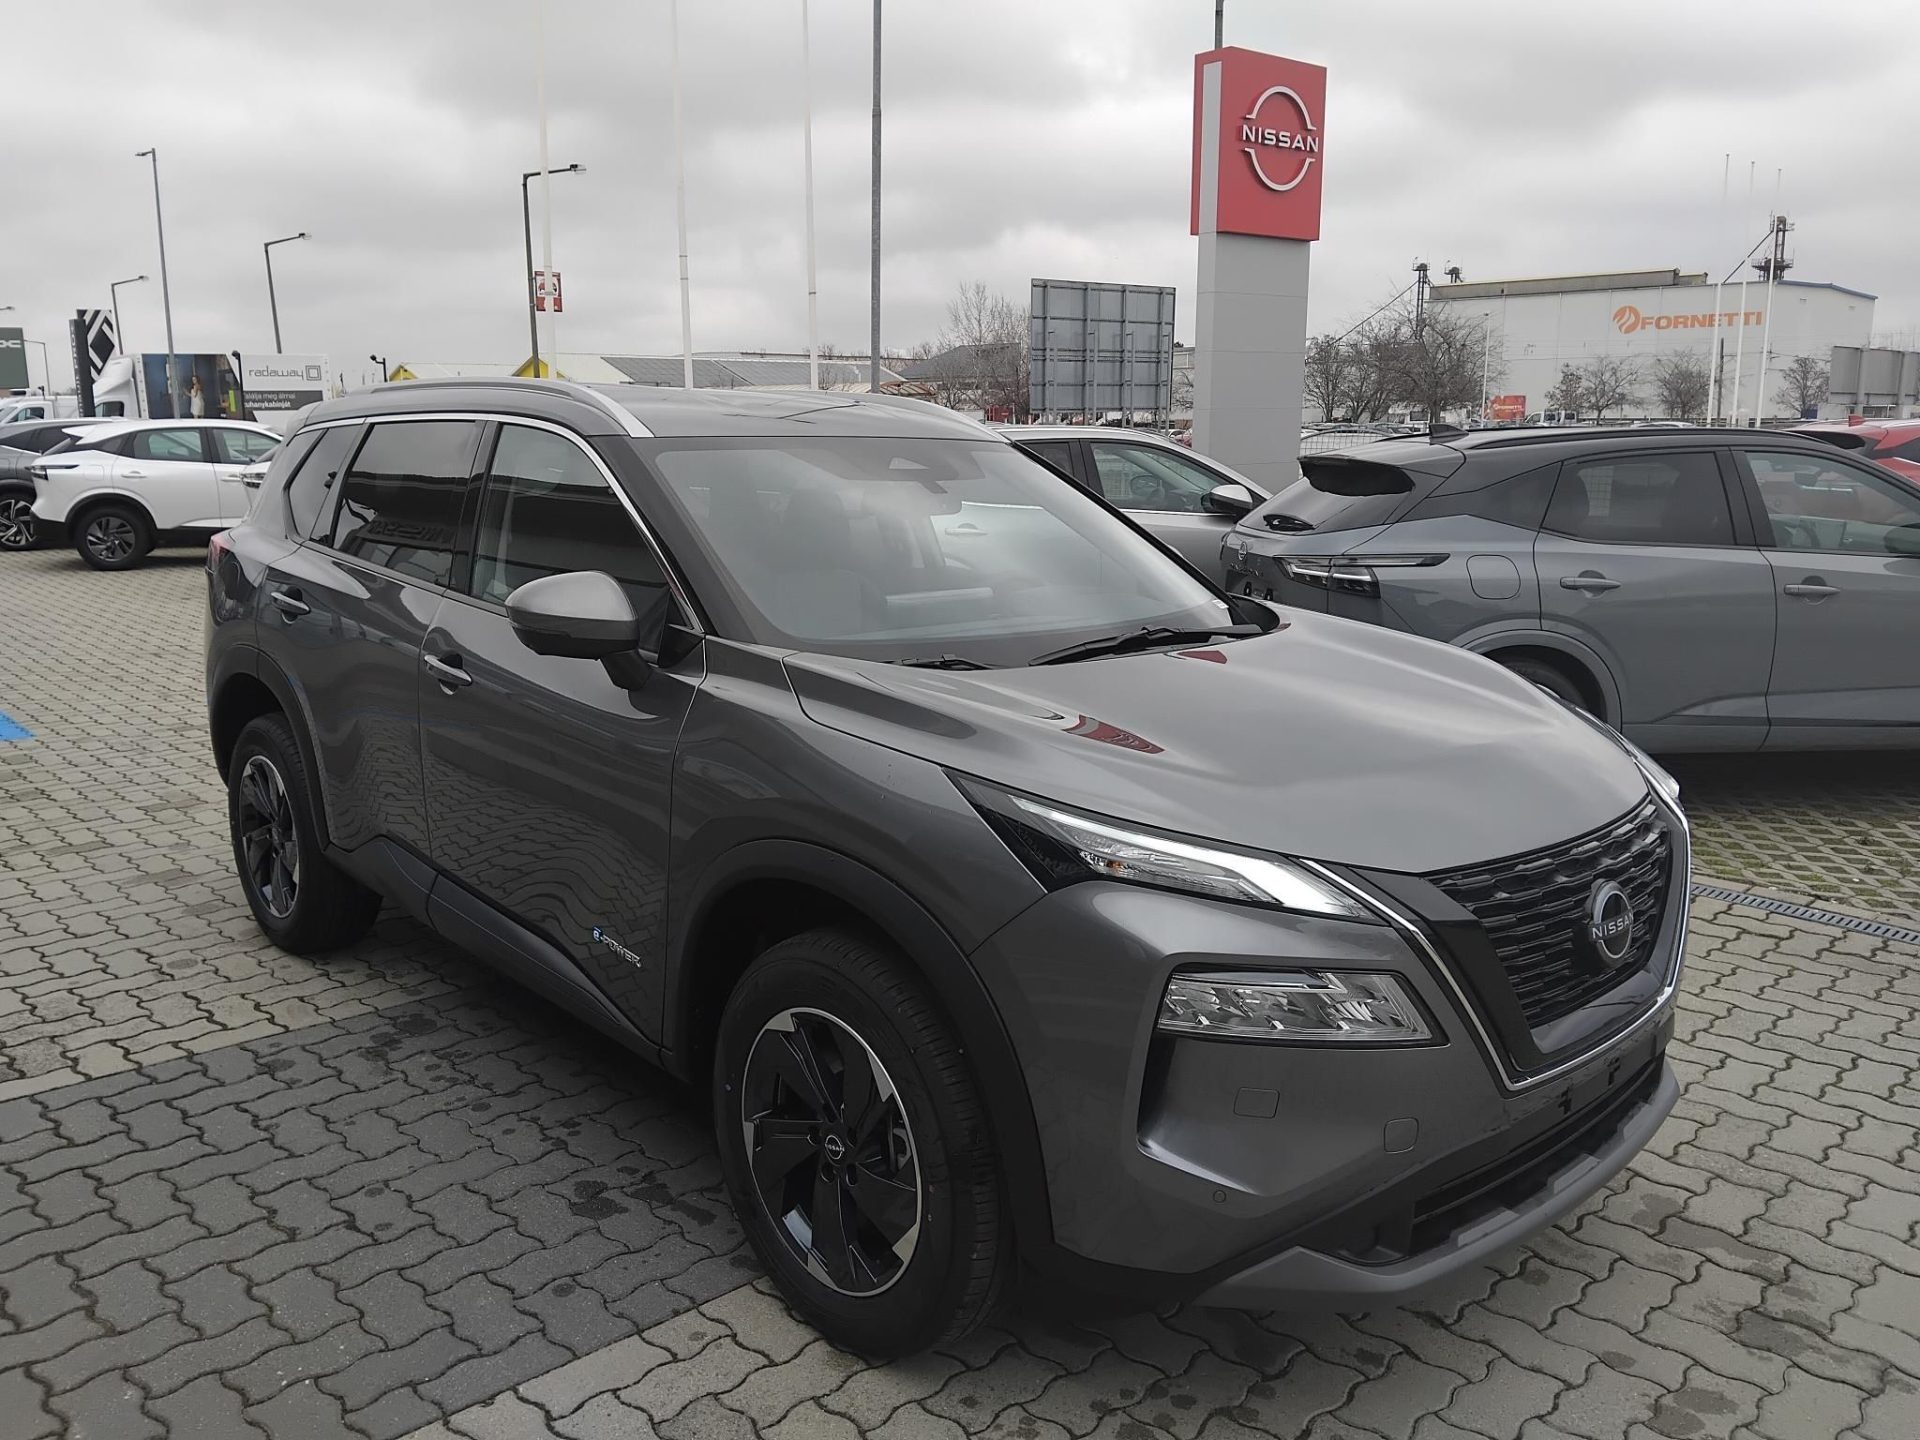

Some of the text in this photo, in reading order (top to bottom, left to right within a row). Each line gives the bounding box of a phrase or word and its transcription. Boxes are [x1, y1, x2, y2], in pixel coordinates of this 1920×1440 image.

[1242, 124, 1319, 153] NISSAN
[1640, 311, 1763, 330] FORNETTI
[248, 365, 305, 381] radaway
[1592, 912, 1634, 939] NISSAN
